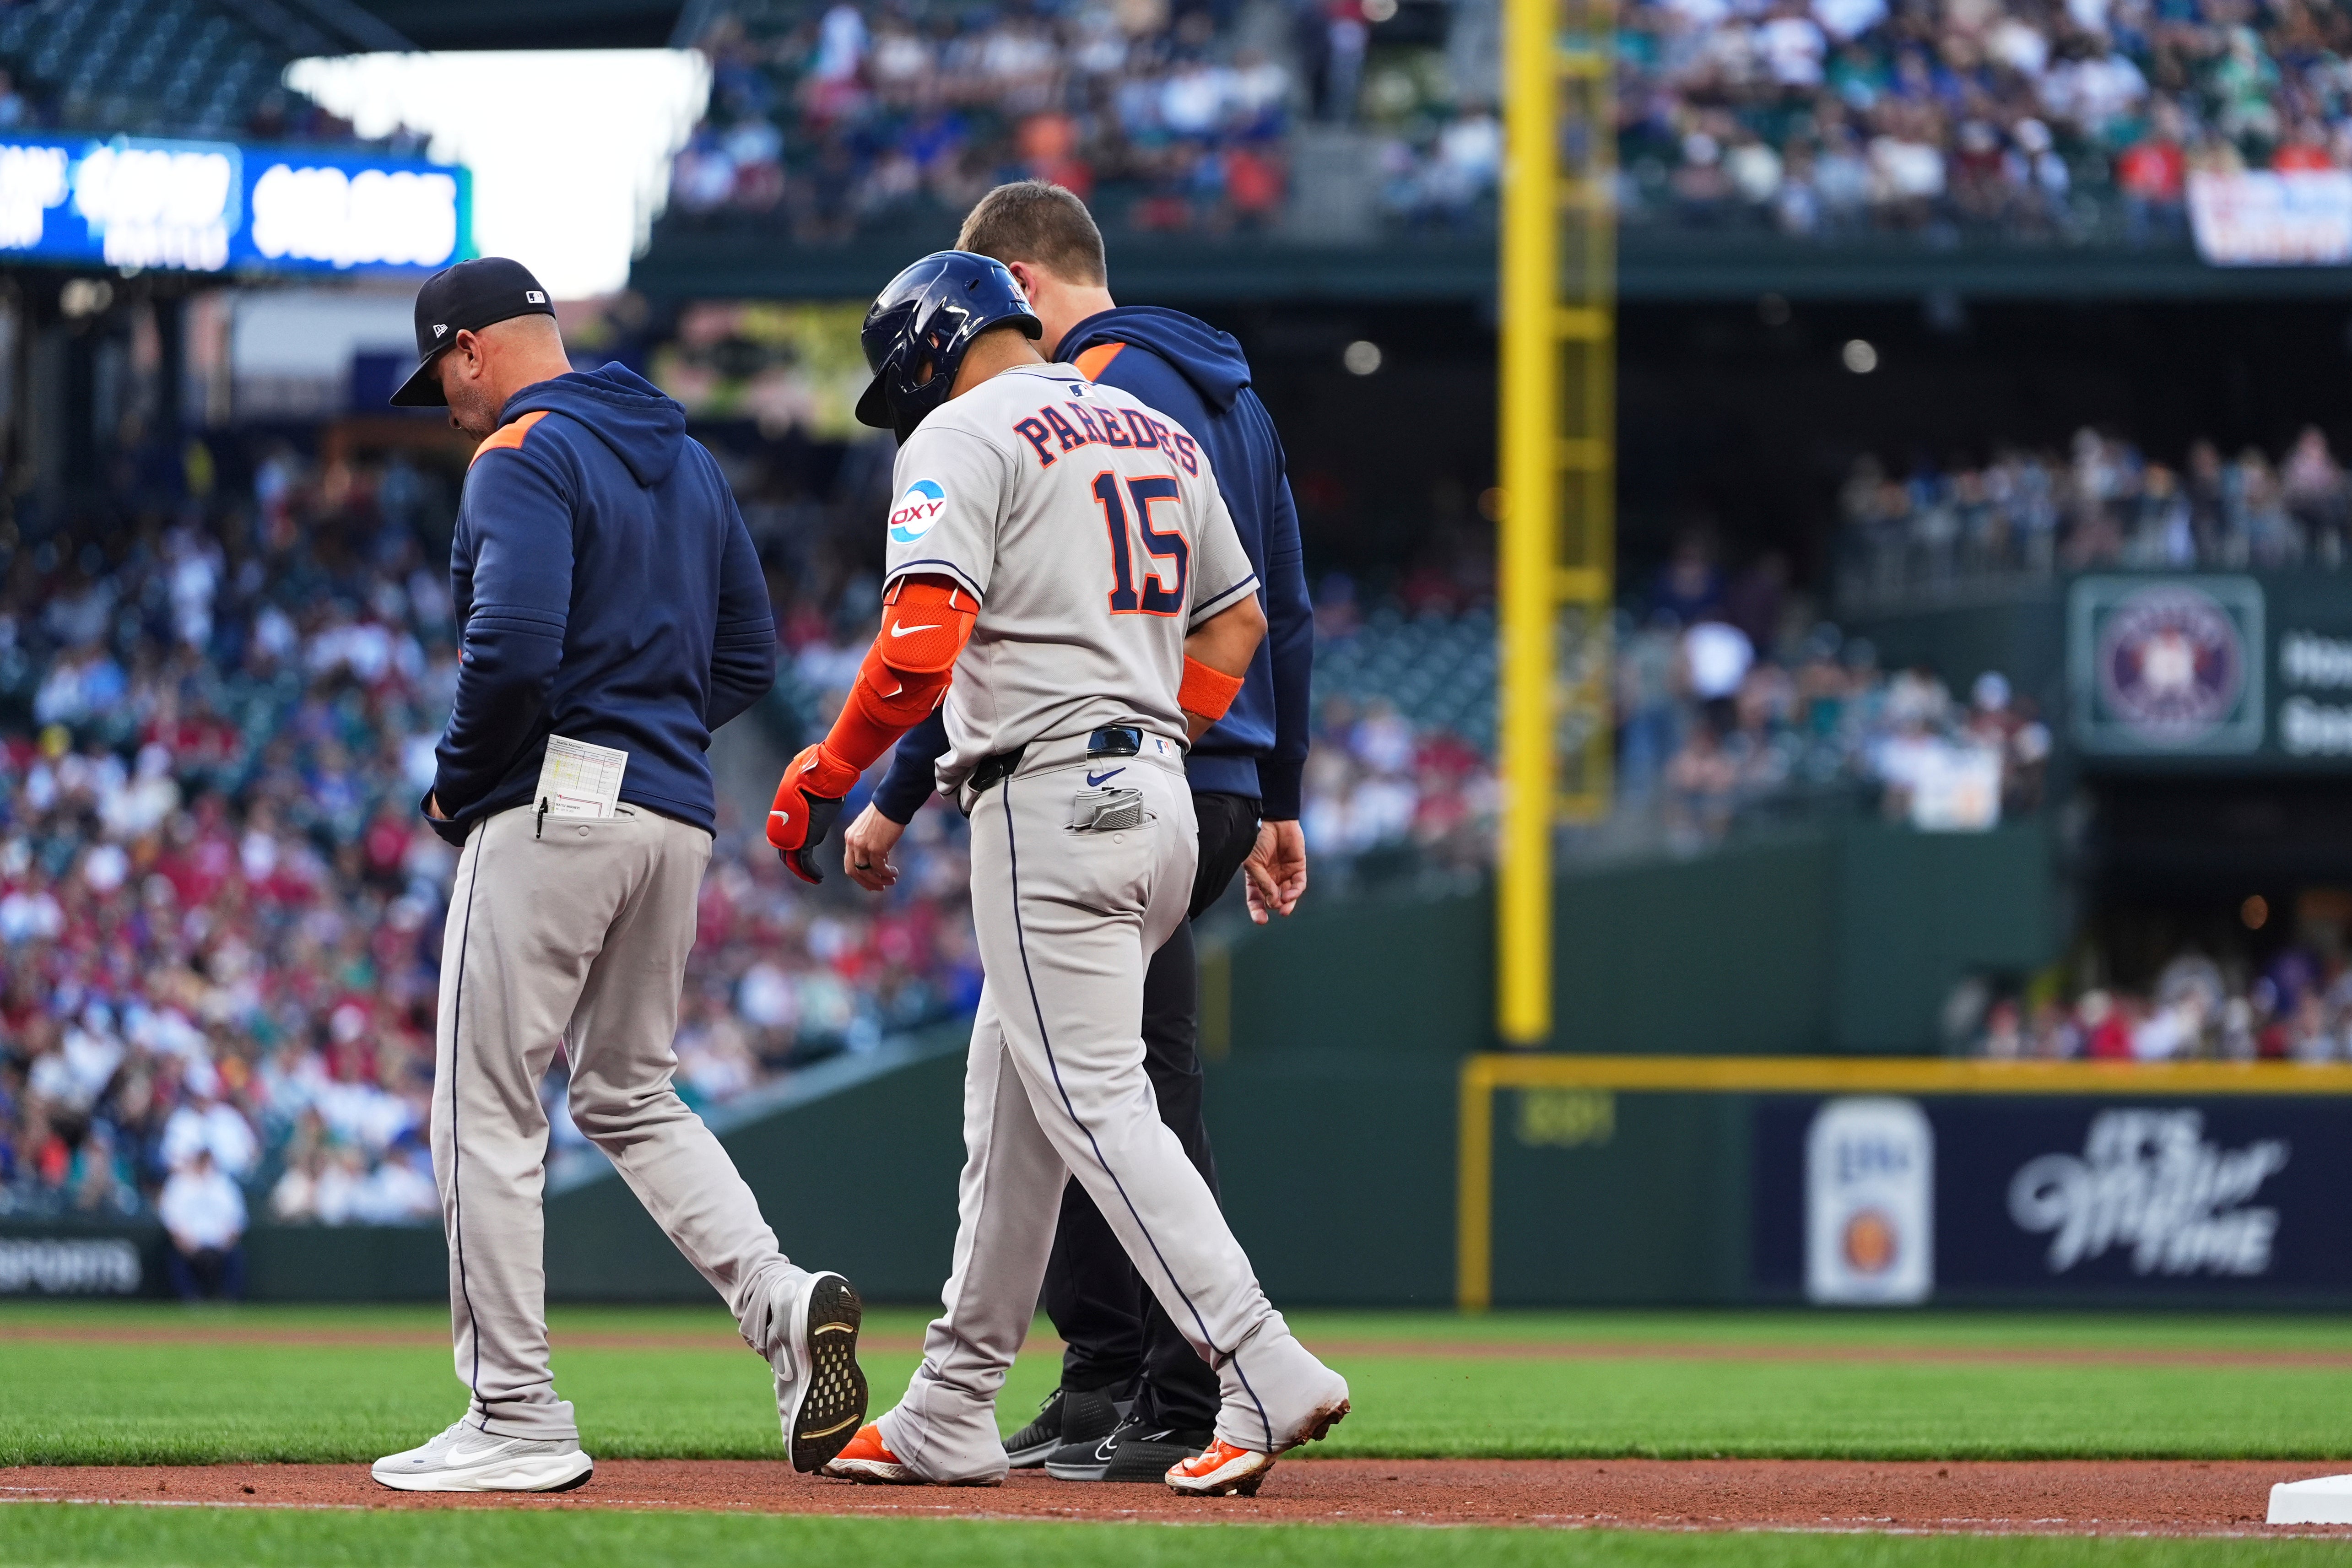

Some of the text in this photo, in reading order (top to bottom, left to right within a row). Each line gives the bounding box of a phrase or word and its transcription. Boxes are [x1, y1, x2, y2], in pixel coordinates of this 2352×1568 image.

[1012, 401, 1198, 478] PAREDES
[891, 502, 944, 524] OXY
[1091, 470, 1189, 616] 15
